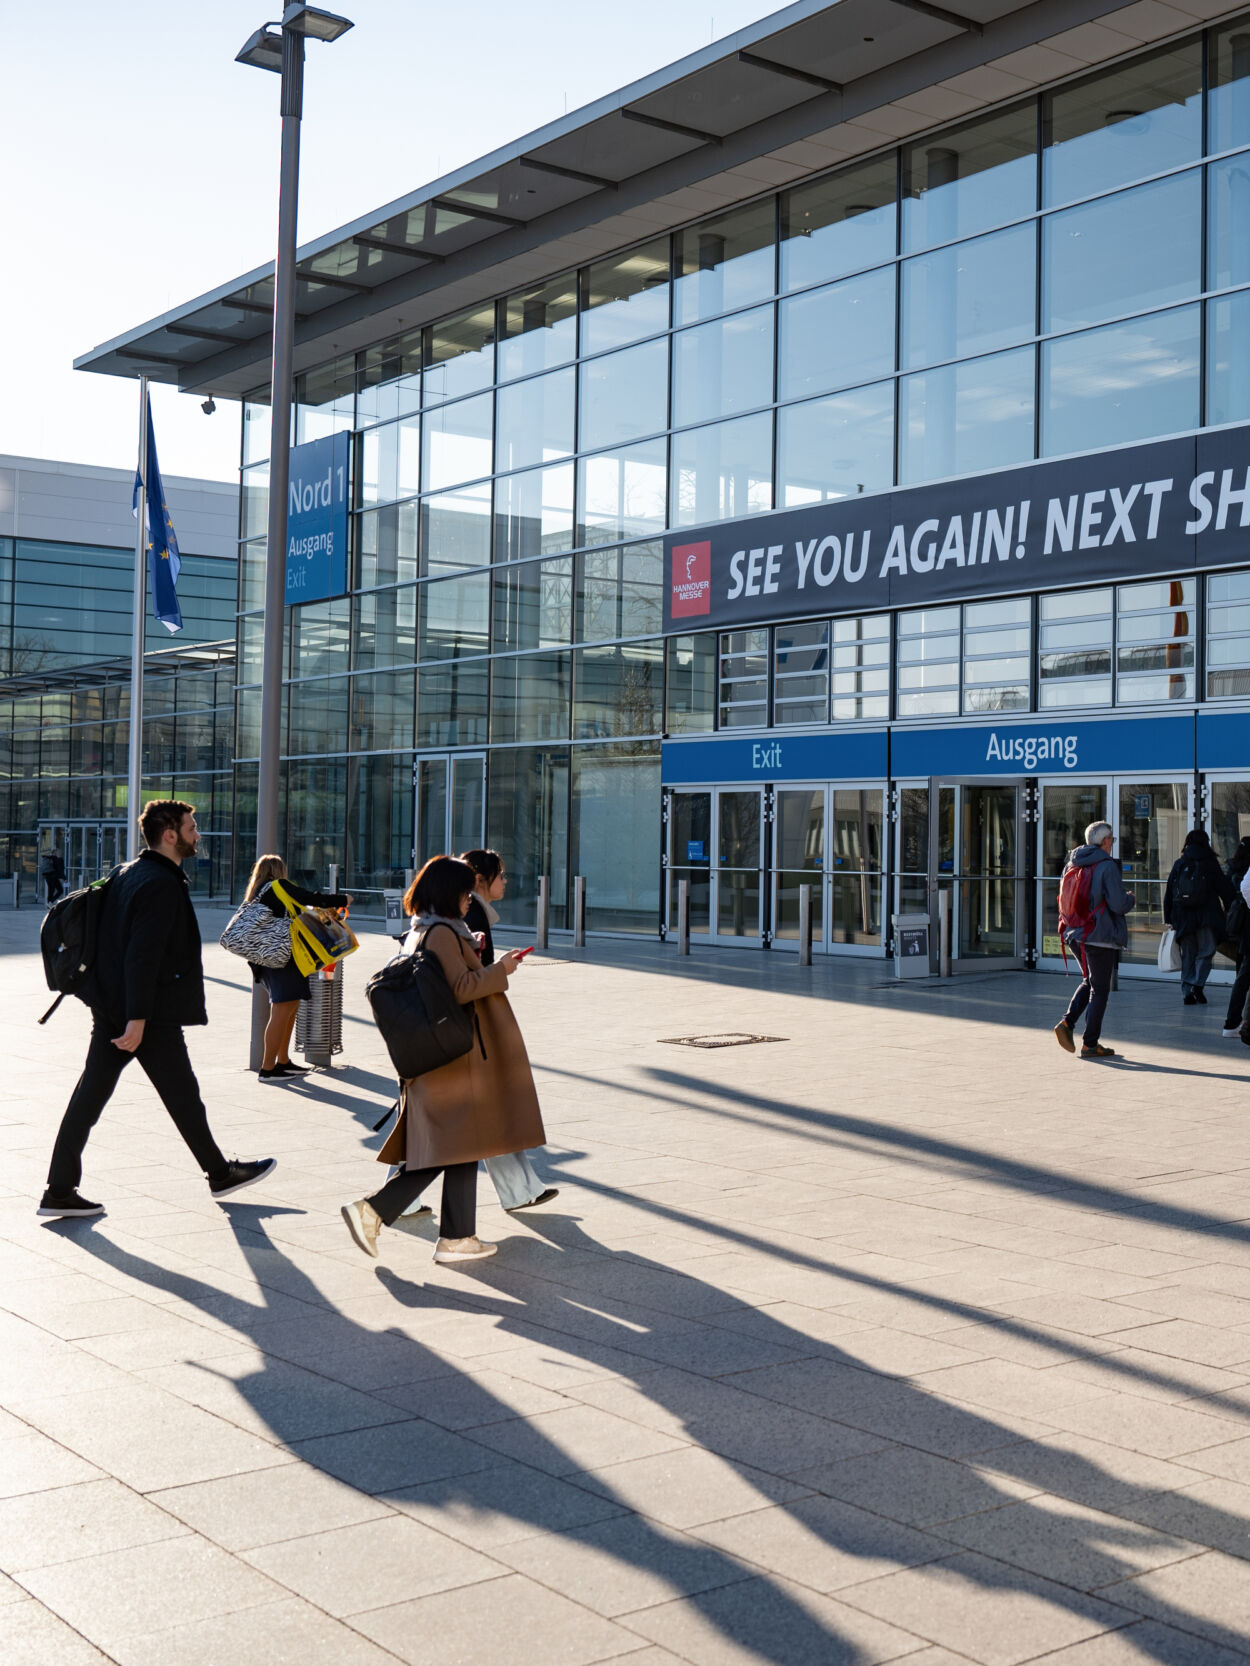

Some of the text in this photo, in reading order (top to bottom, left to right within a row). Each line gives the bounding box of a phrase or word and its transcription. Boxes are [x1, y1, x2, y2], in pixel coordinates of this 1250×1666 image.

[289, 465, 344, 516] Nord 1
[288, 531, 334, 560] Ausgang
[727, 544, 784, 600] SEE
[795, 529, 872, 590] YOU
[879, 499, 1031, 579] AGAIN!
[1044, 478, 1174, 555] NEXT
[287, 565, 307, 589] Exit
[673, 580, 709, 592] HANNOVER
[679, 590, 702, 600] MESSE
[752, 743, 782, 769] Exit
[985, 732, 1078, 770] Ausgang
